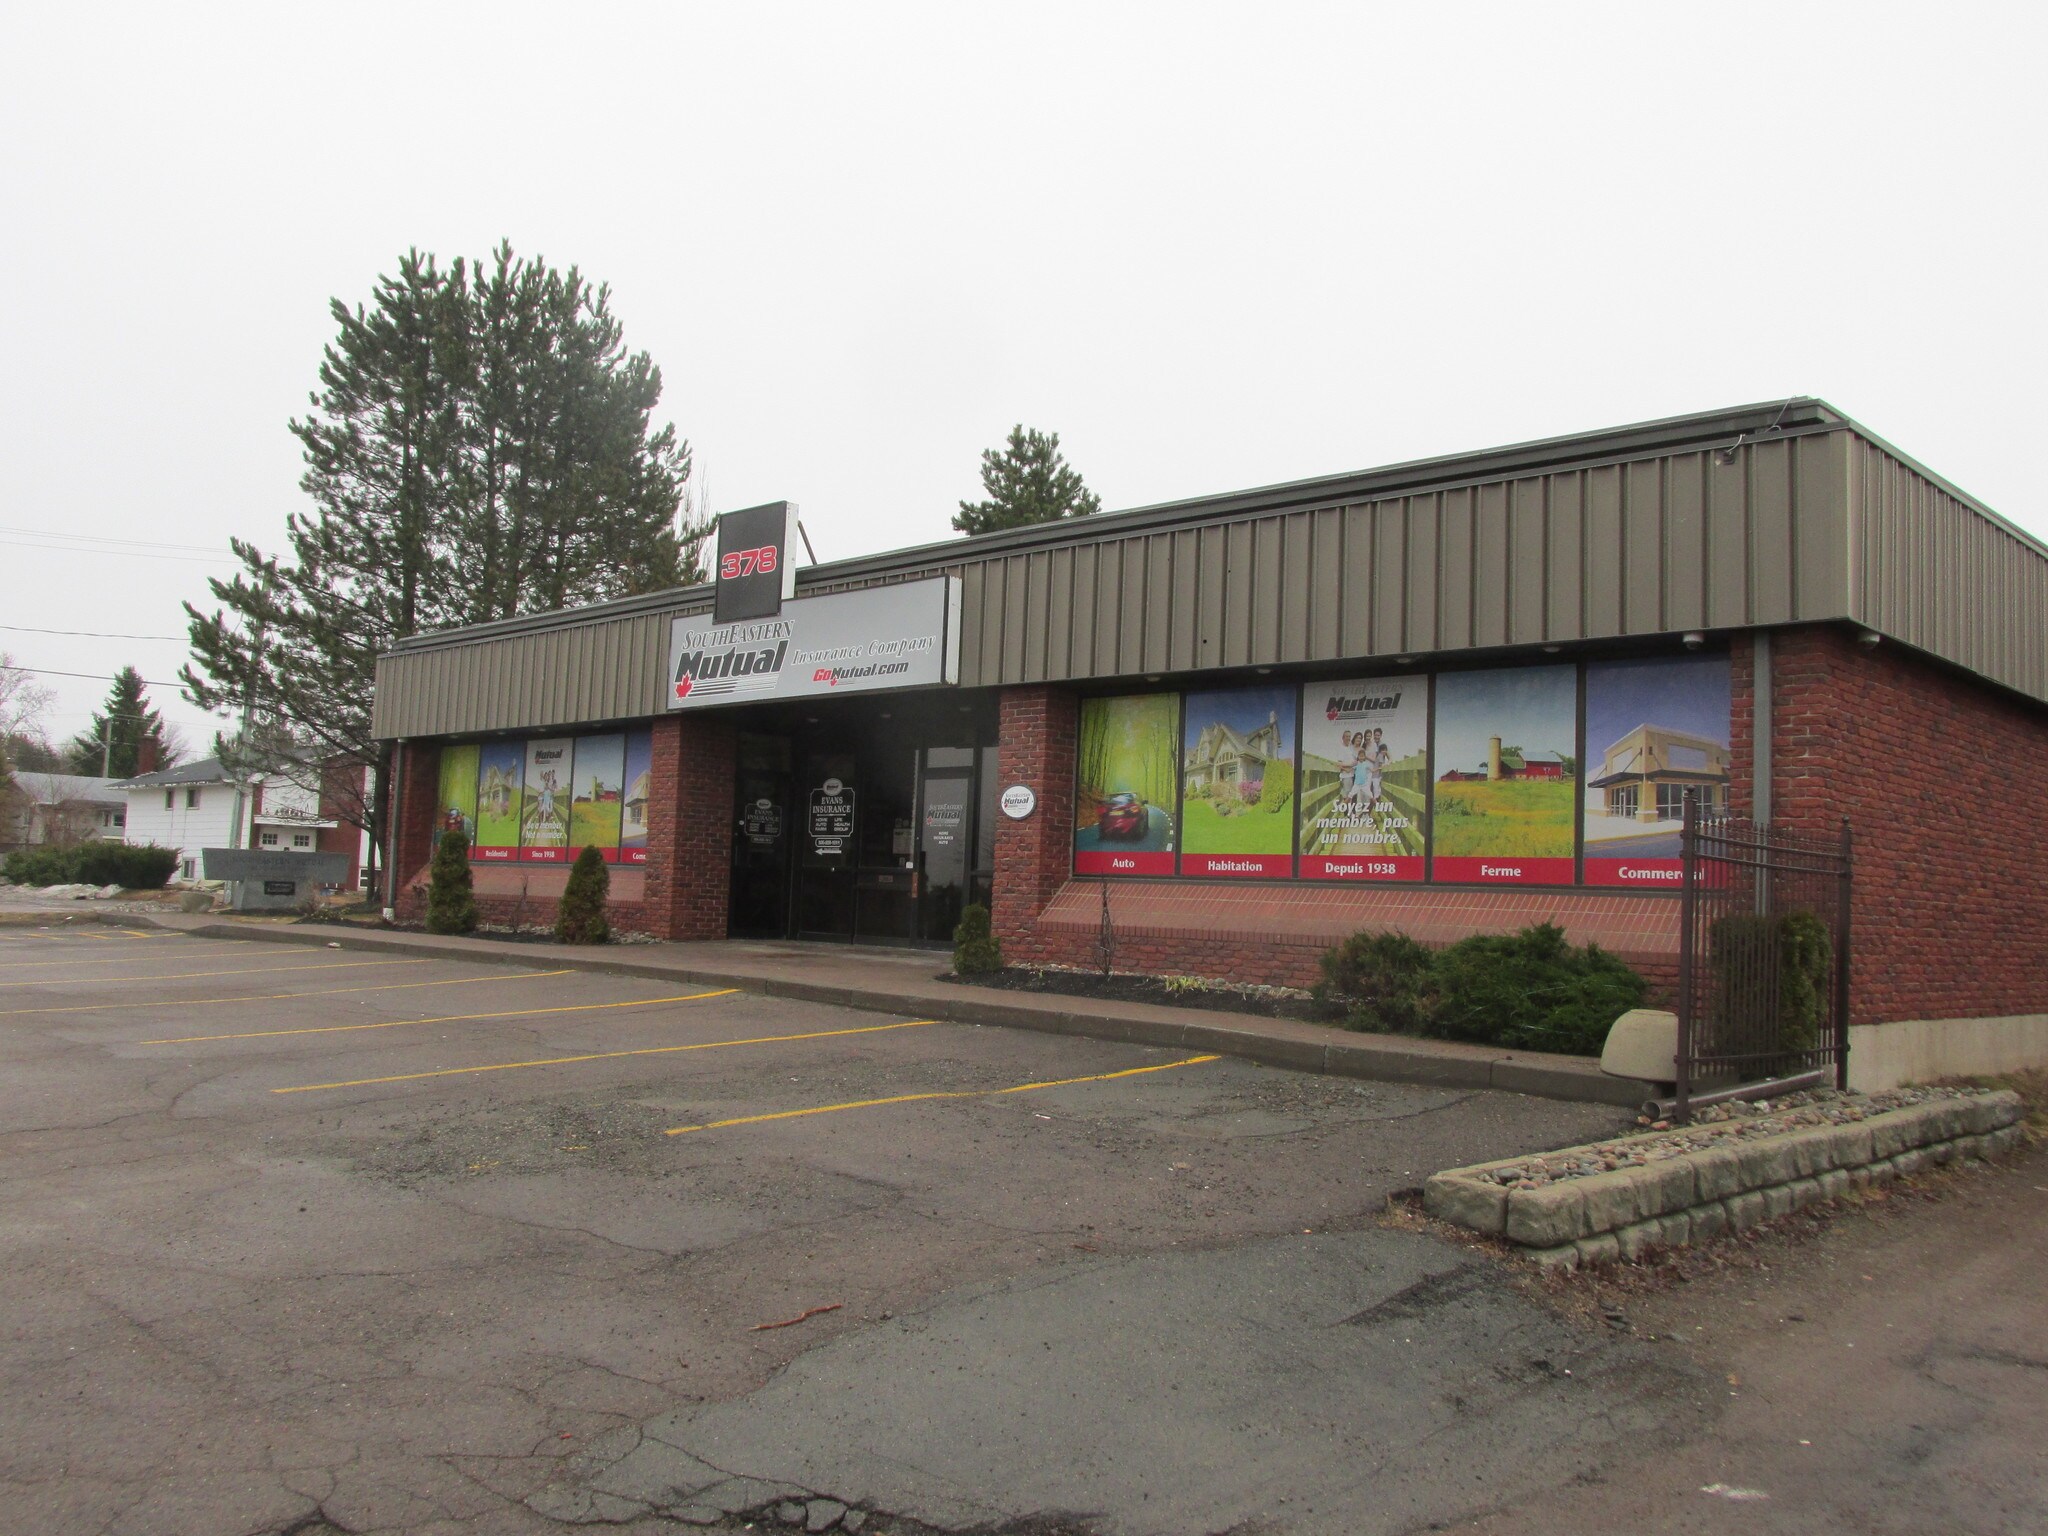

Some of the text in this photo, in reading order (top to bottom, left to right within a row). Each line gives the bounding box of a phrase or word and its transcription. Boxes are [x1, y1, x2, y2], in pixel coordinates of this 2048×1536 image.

[721, 545, 777, 580] 378
[791, 635, 937, 666] Insurance Company
[674, 640, 789, 683] Mutual
[812, 661, 909, 683] GoMutual.com
[1326, 693, 1401, 713] Mutual
[535, 749, 563, 760] Mutual
[821, 796, 843, 805] EVANS
[1004, 797, 1029, 805] Mutual
[812, 805, 851, 814] INSURANCE
[1331, 799, 1394, 816] Soyez un
[927, 810, 960, 819] Mutual
[1316, 814, 1409, 832] membre, pas
[1321, 829, 1402, 844] un nombre.
[485, 850, 508, 858] Residential
[531, 850, 555, 858] Since 1938
[1112, 858, 1135, 868] Auto
[1208, 861, 1262, 871] Habitation
[1325, 862, 1396, 876] Depuis 1938
[1481, 865, 1521, 877] Ferme
